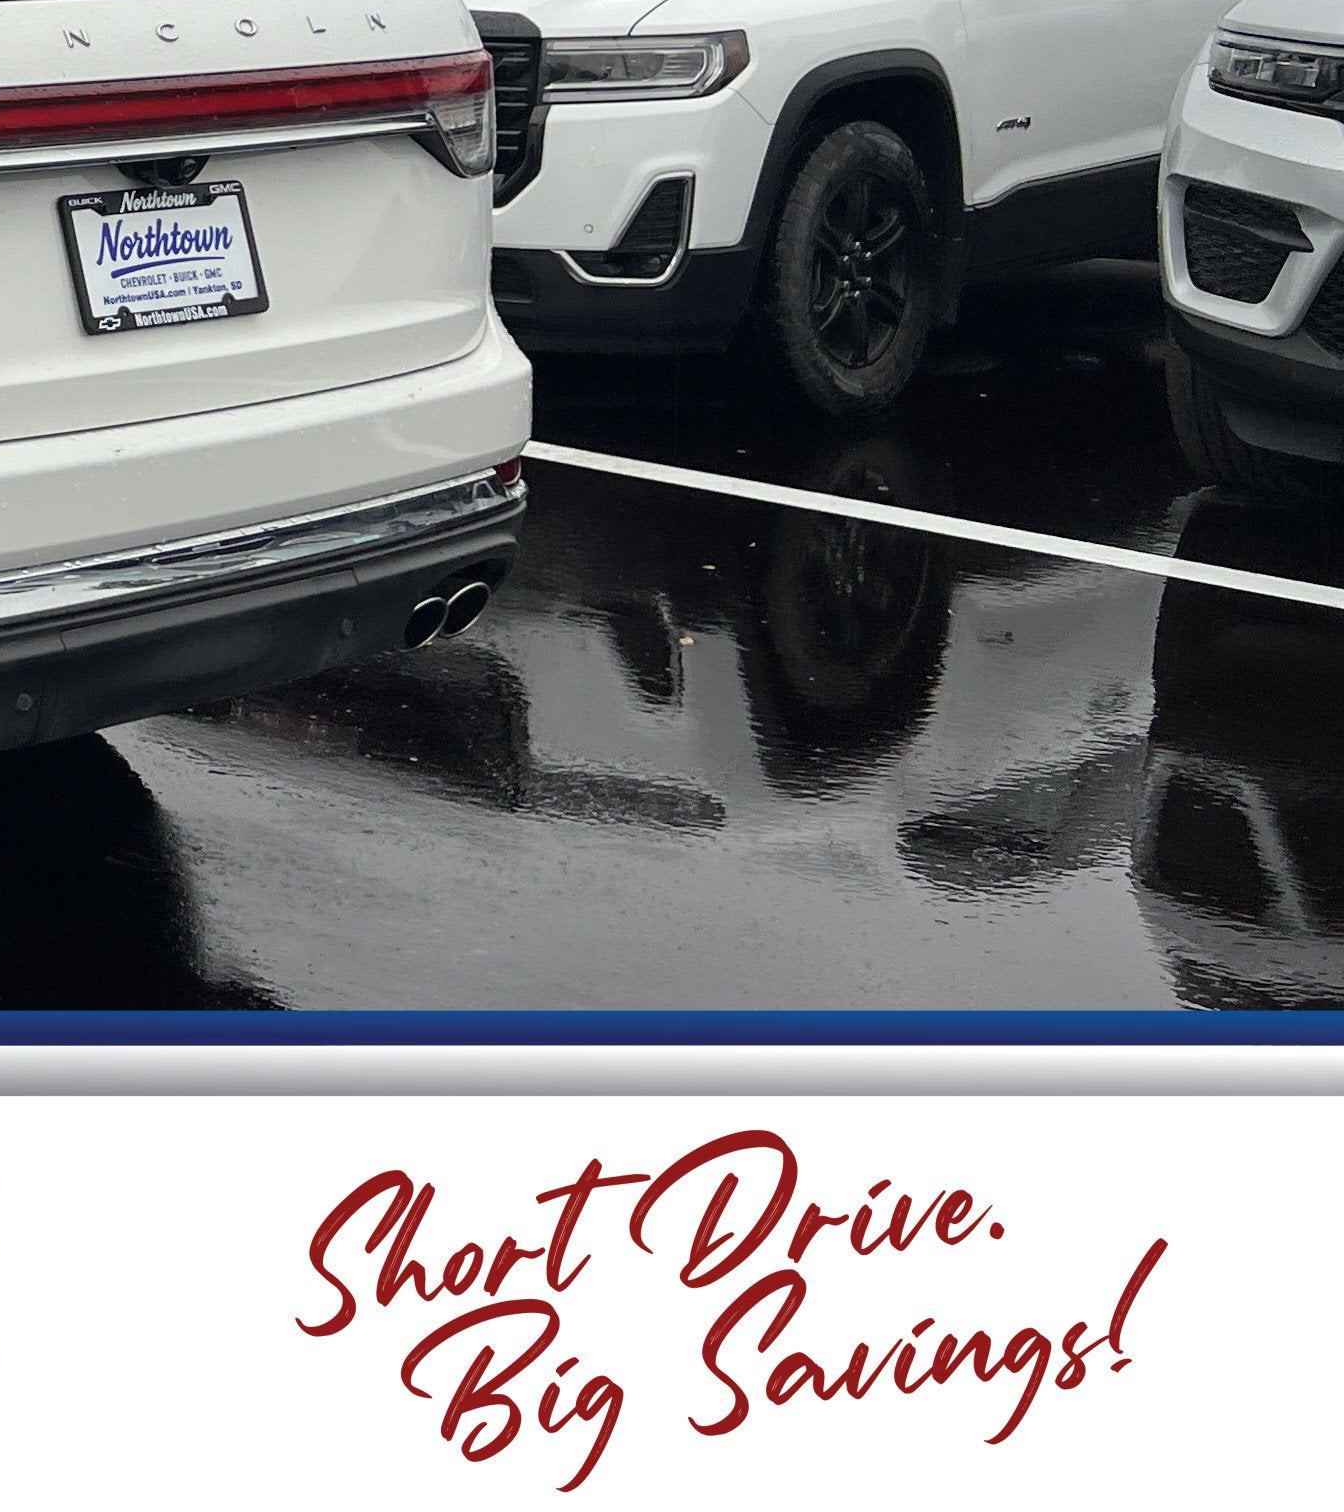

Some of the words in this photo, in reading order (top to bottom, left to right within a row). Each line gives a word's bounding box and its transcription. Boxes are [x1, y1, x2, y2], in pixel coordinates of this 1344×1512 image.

[67, 196, 104, 207] BUICK
[119, 189, 197, 214] Northtown
[209, 182, 241, 194] GMC
[96, 218, 233, 266] Northtown
[120, 273, 167, 288] CHEVROLET
[173, 270, 199, 283] BUICK
[204, 267, 223, 279] GMC
[103, 288, 186, 305] NorthtownUSA.com
[193, 282, 229, 295] Yankton,
[230, 280, 243, 291] SD
[134, 304, 228, 327] NorthtownUSA.com
